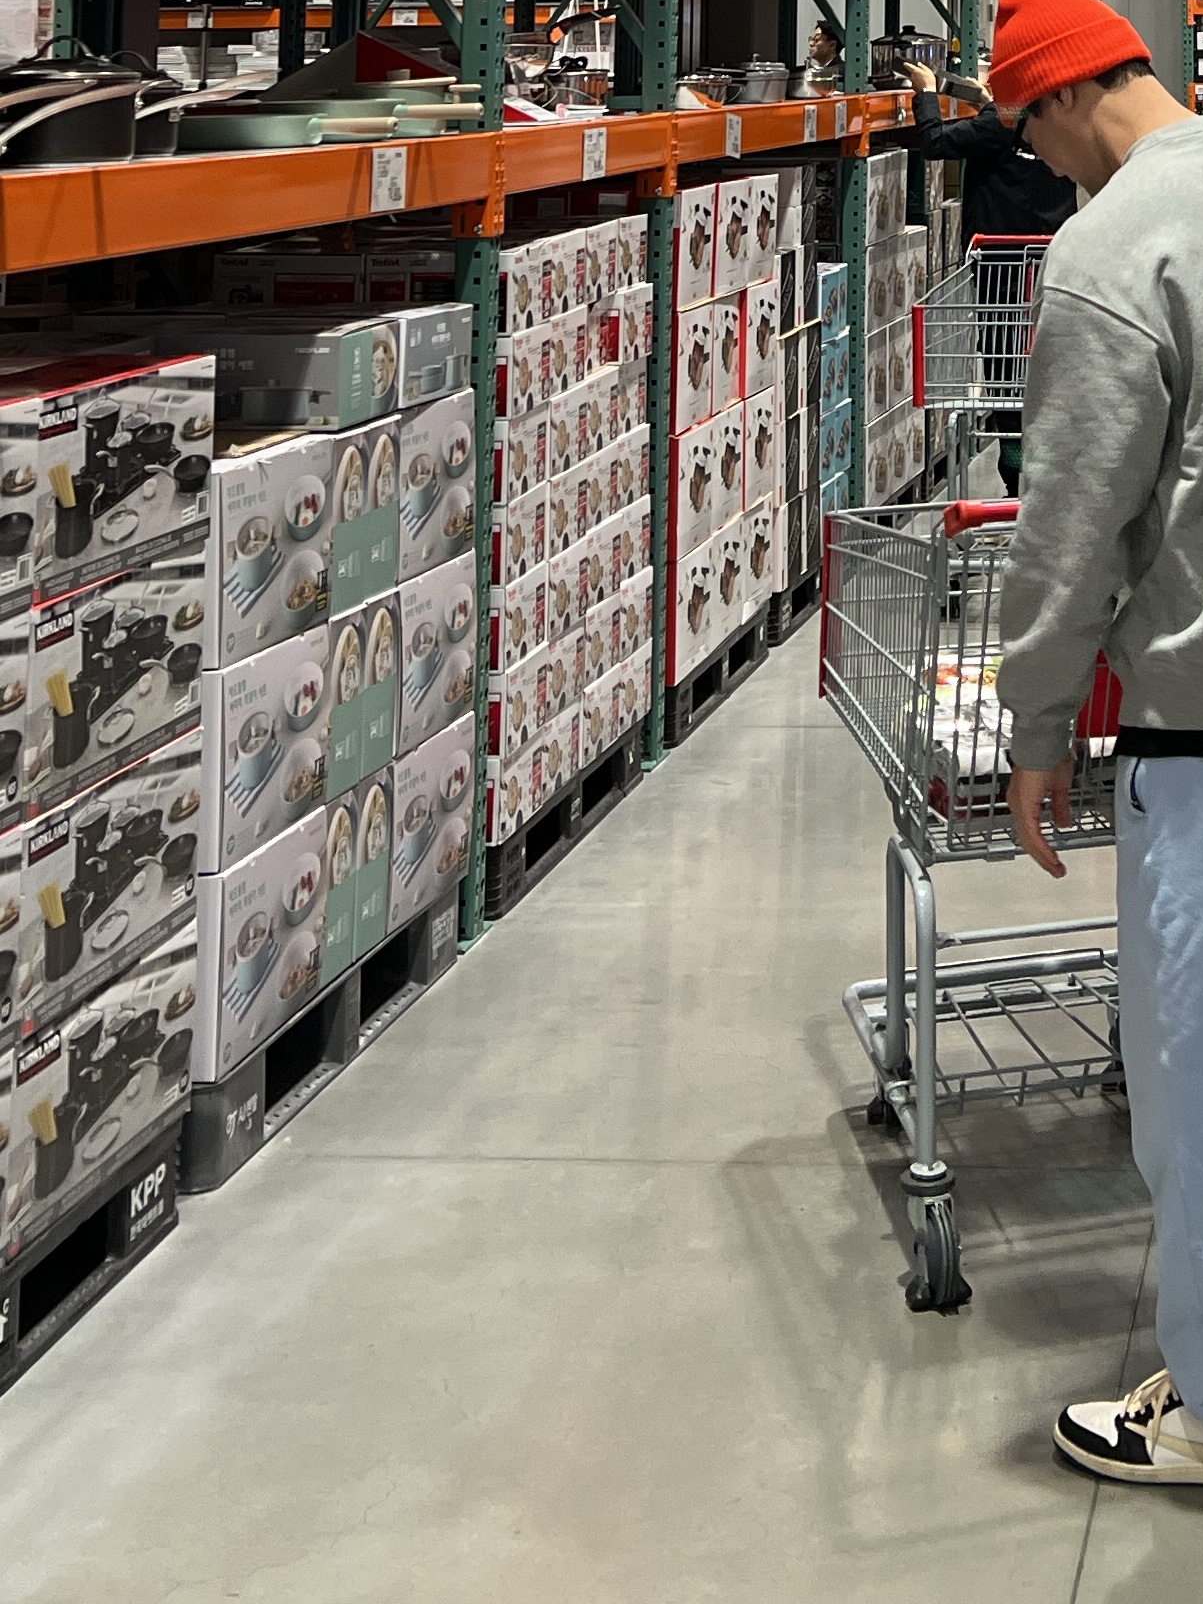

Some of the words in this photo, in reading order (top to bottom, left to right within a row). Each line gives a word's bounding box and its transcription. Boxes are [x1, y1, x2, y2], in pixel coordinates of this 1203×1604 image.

[371, 257, 400, 267] Tefal
[30, 820, 69, 853] KIRKLAND
[130, 1162, 167, 1219] KPP
